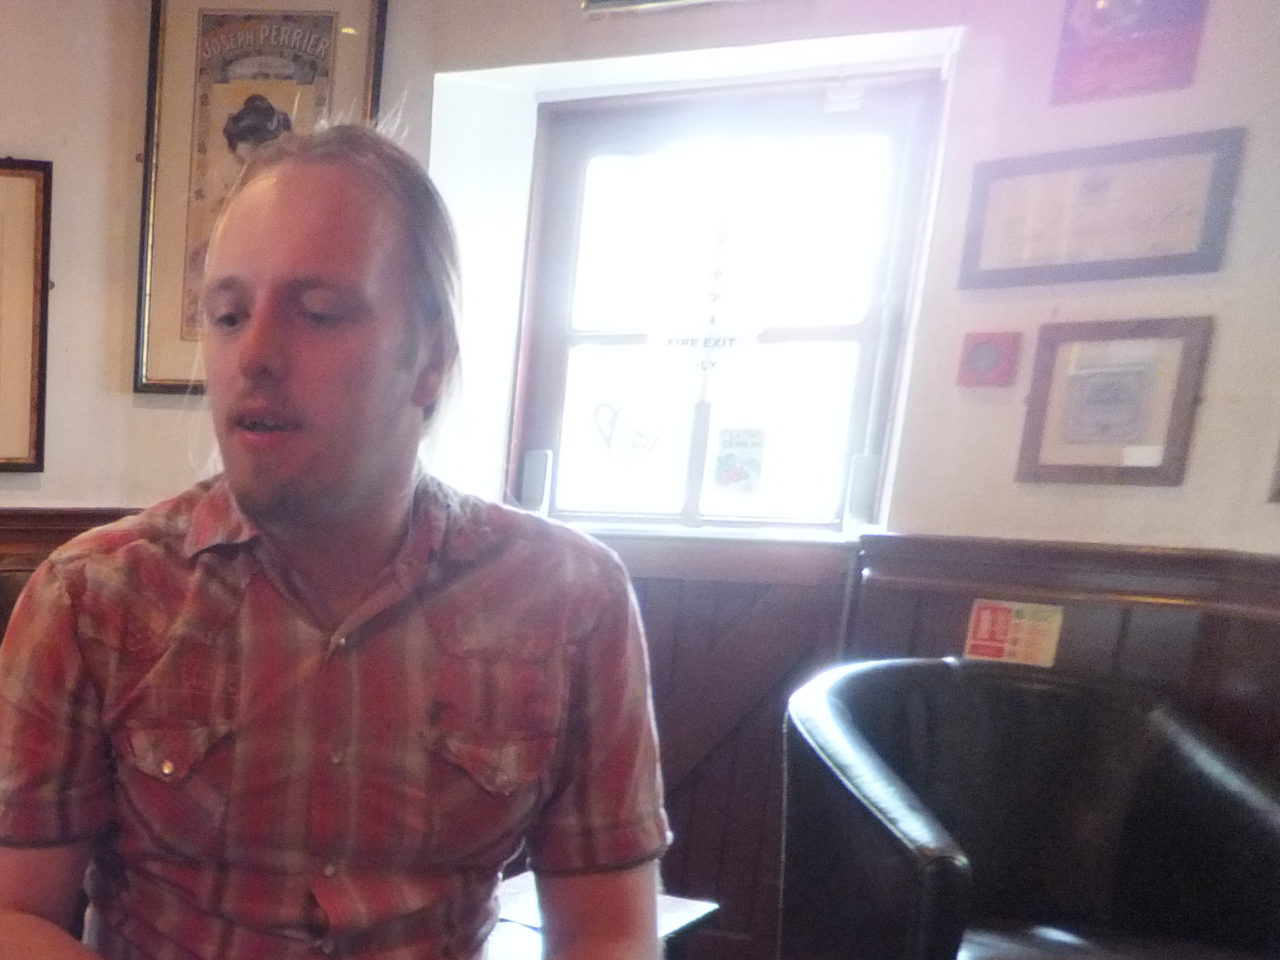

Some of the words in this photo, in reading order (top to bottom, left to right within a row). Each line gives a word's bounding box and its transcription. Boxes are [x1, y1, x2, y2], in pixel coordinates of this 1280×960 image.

[202, 30, 255, 59] JOSEPH
[259, 24, 330, 59] PERRIER
[667, 337, 699, 347] FIRE
[702, 337, 737, 348] EXIT
